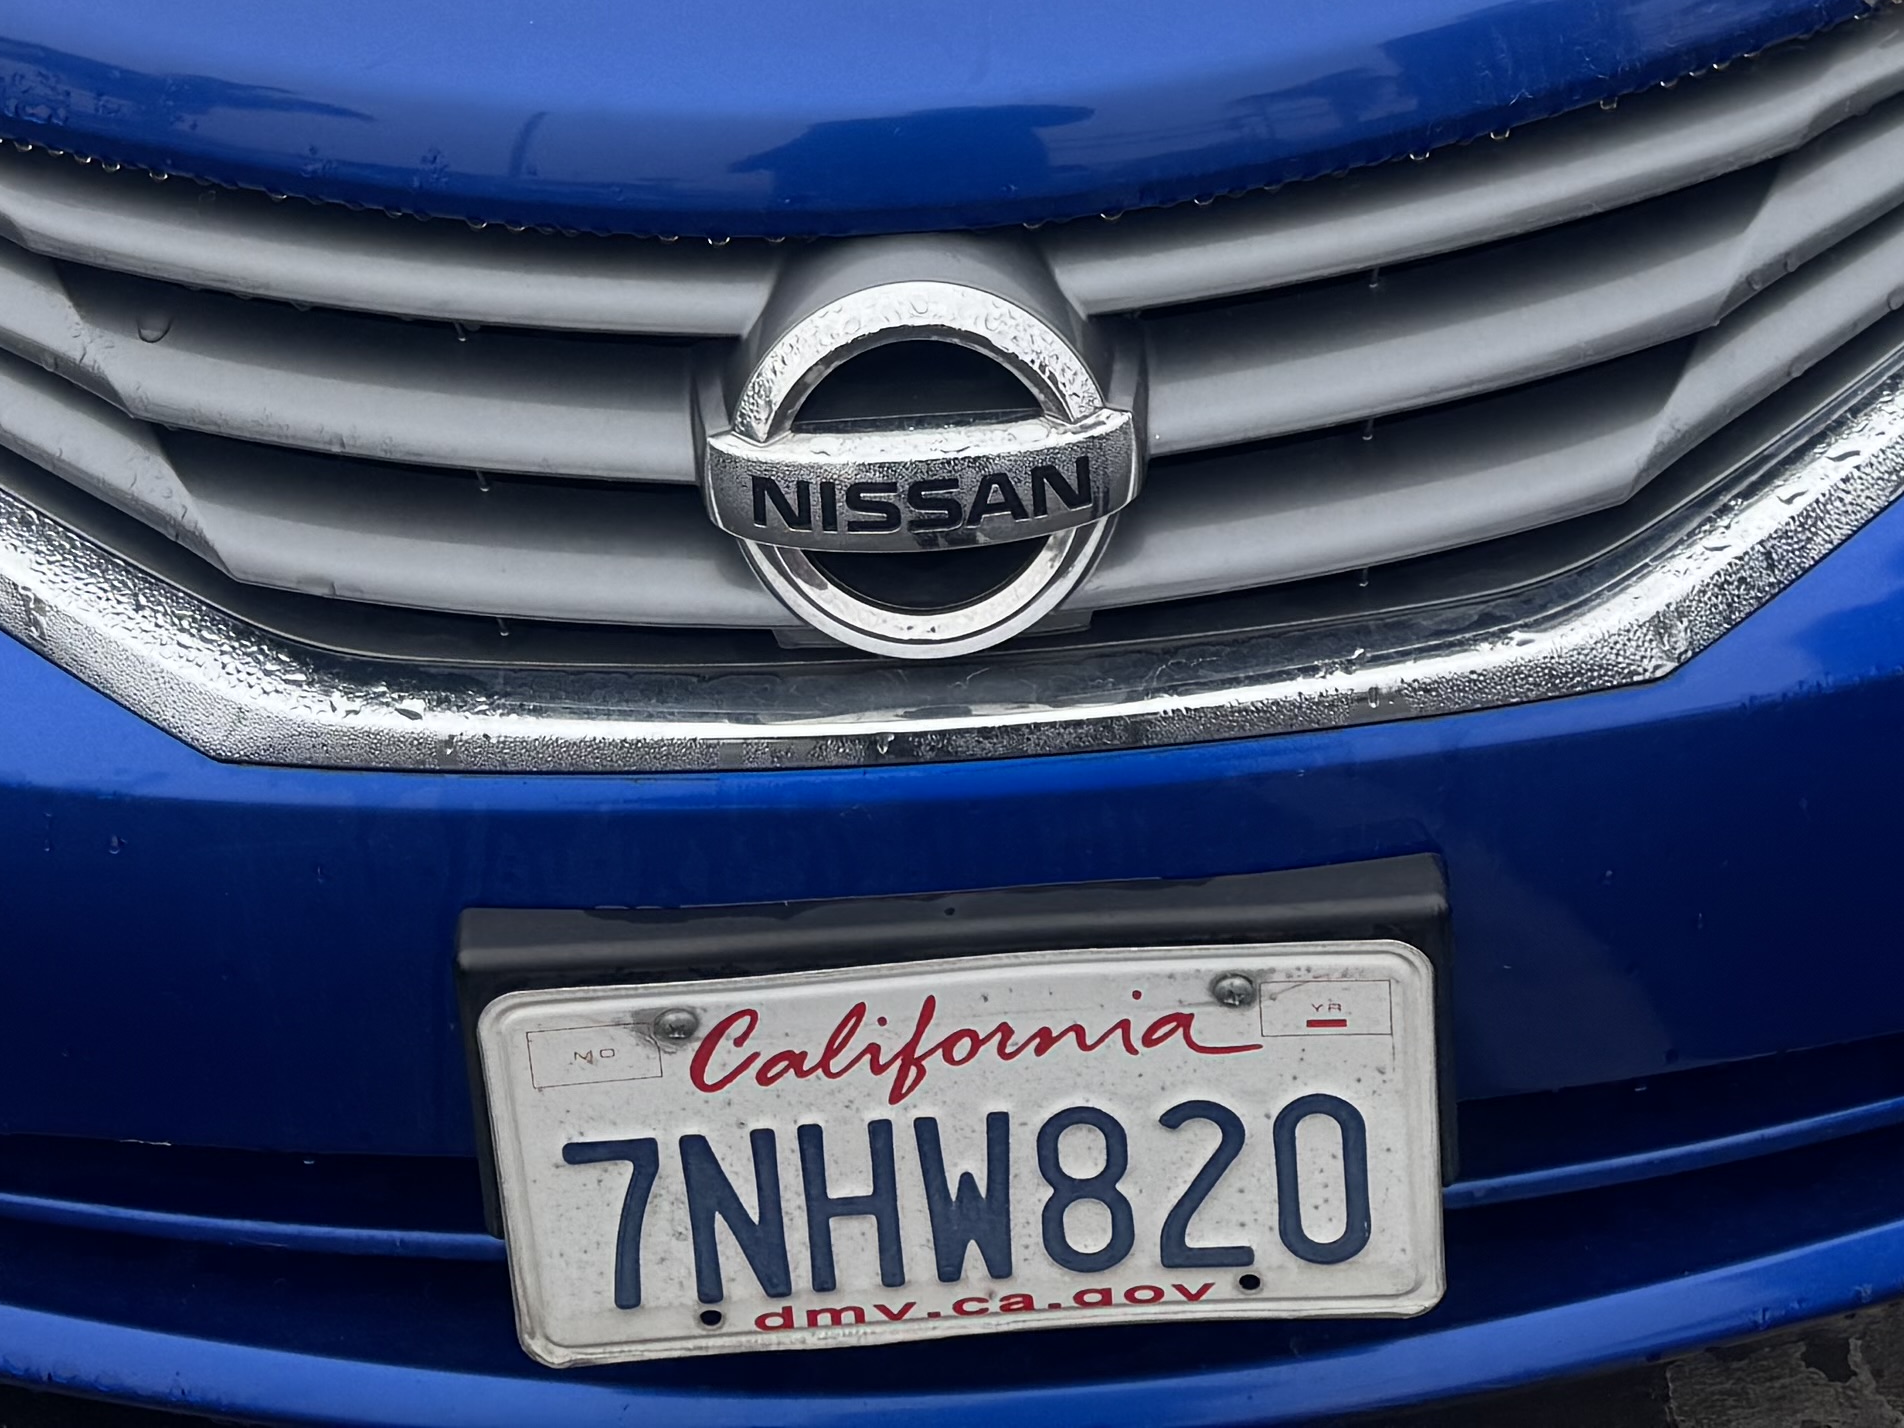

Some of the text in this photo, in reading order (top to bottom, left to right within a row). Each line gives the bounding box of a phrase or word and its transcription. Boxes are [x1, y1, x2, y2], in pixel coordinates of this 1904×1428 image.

[752, 456, 1094, 533] NISSAN
[690, 989, 1263, 1104] California
[561, 1093, 1371, 1309] 7NHW820
[754, 1279, 1216, 1333] dmv.ca.gov
